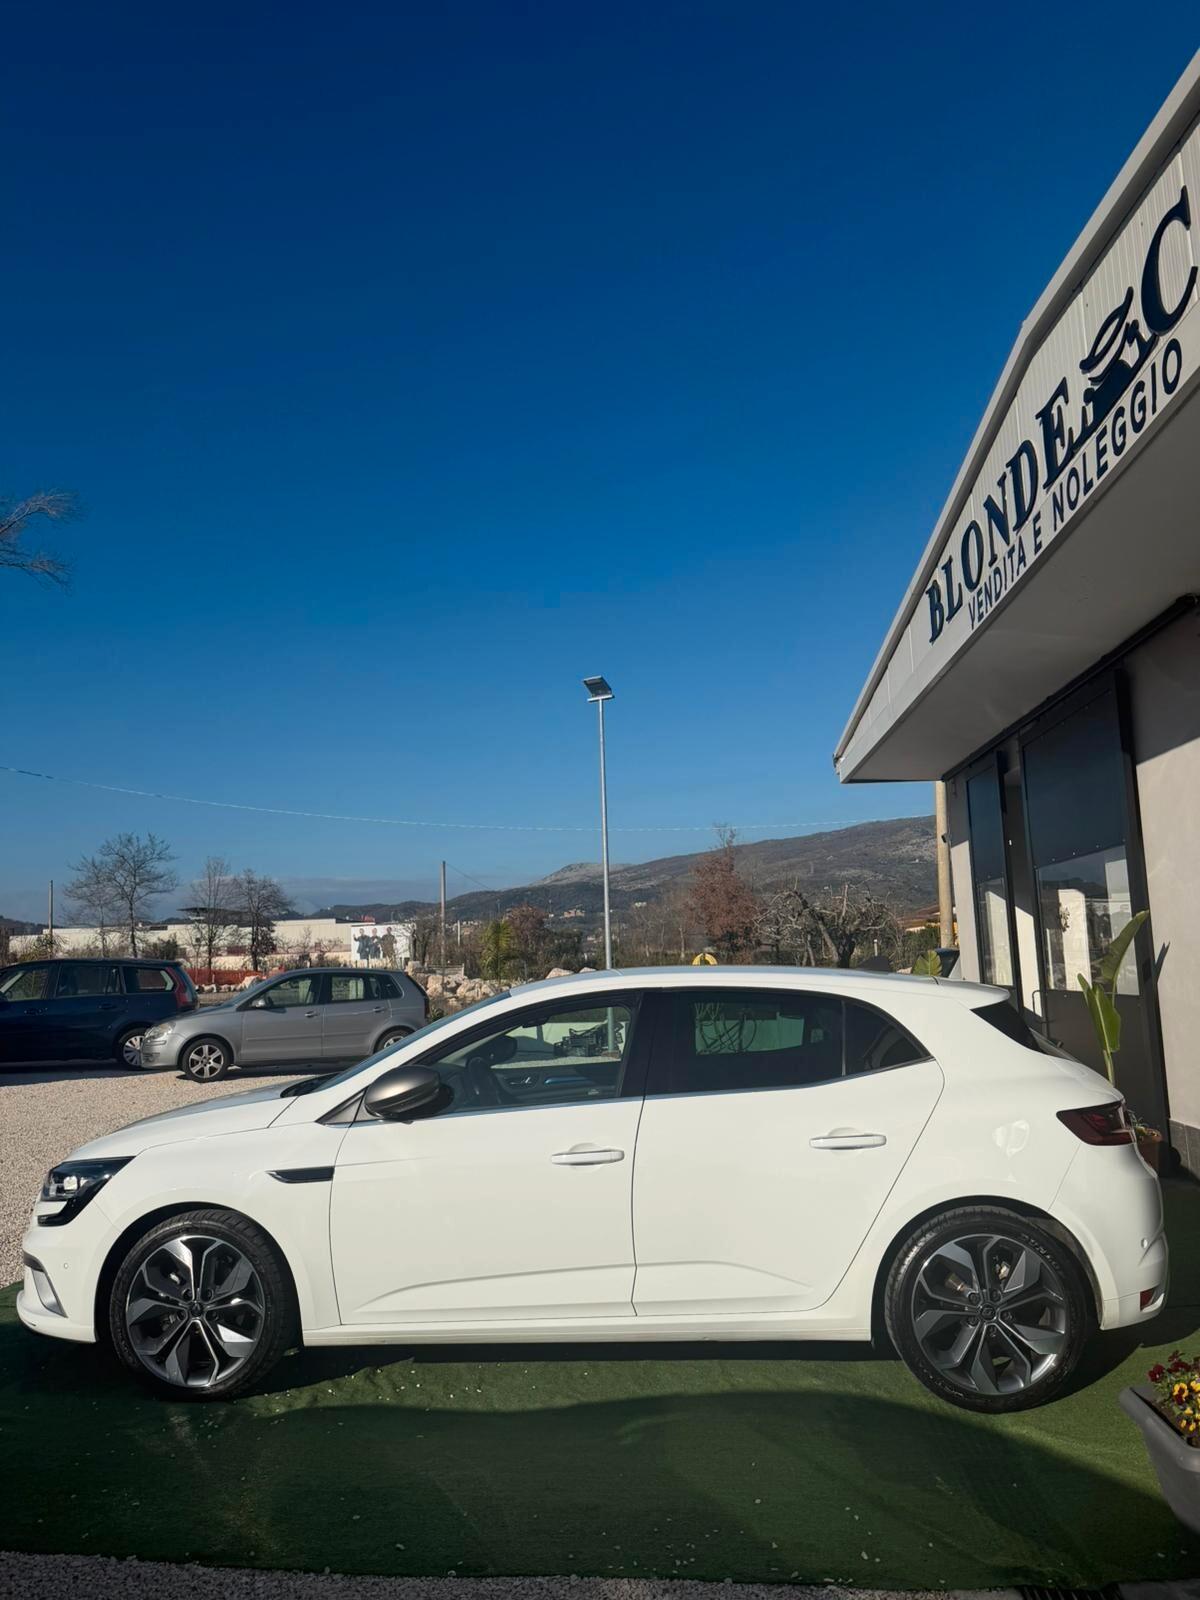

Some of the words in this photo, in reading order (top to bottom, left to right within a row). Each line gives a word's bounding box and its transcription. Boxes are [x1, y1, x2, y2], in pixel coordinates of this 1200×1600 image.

[925, 377, 1075, 643] BLONDE
[968, 534, 1027, 631] VENDITA
[1033, 511, 1043, 555] E
[1052, 338, 1182, 533] NOLEGGIO
